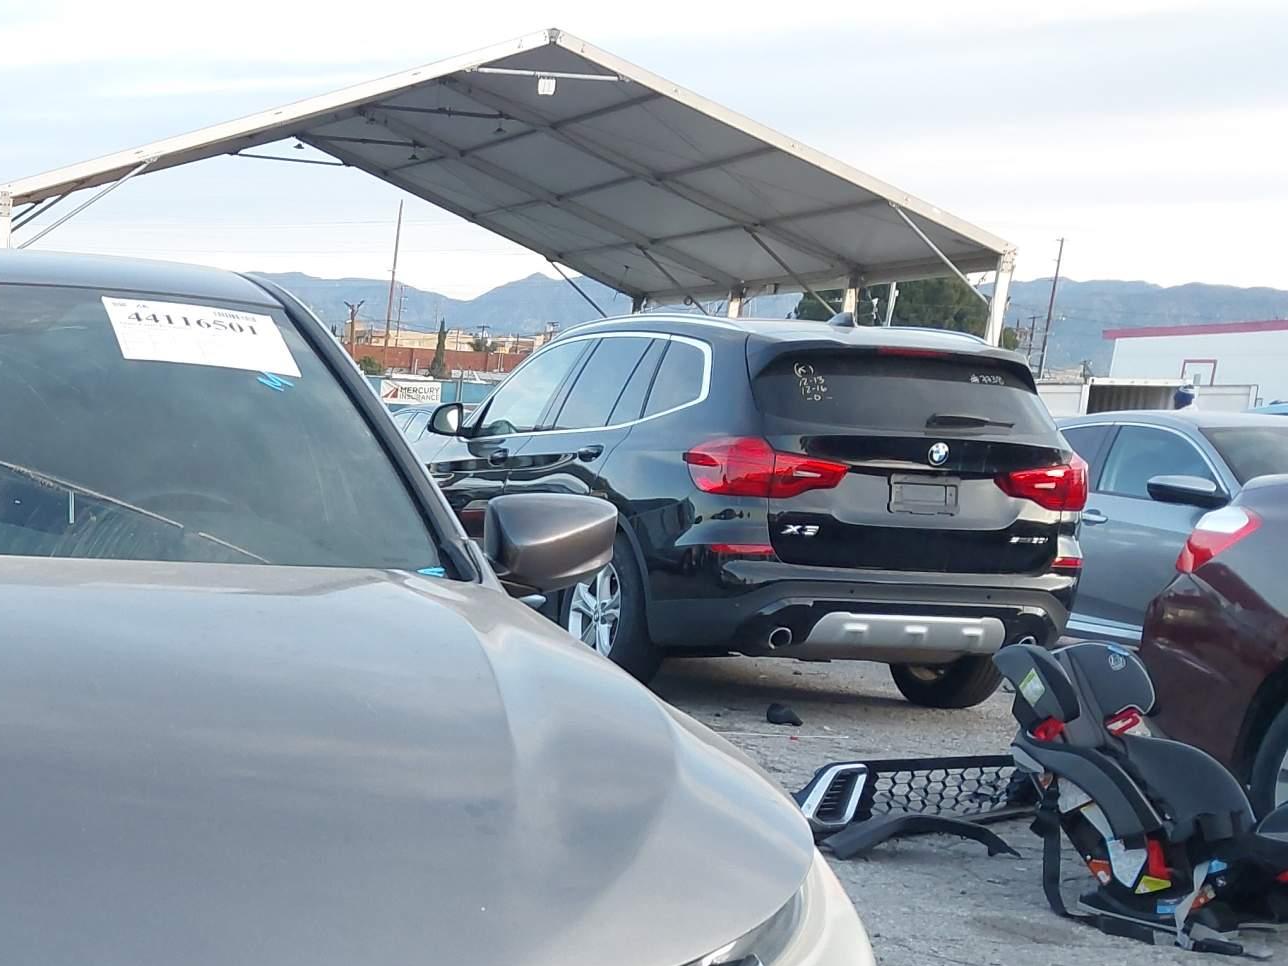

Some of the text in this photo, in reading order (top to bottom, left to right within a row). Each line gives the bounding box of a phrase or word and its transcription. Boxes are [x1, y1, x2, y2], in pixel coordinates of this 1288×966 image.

[127, 311, 259, 336] 44116501
[400, 386, 440, 394] MERCURY
[400, 393, 440, 401] INSURANCE
[780, 524, 820, 536] X3
